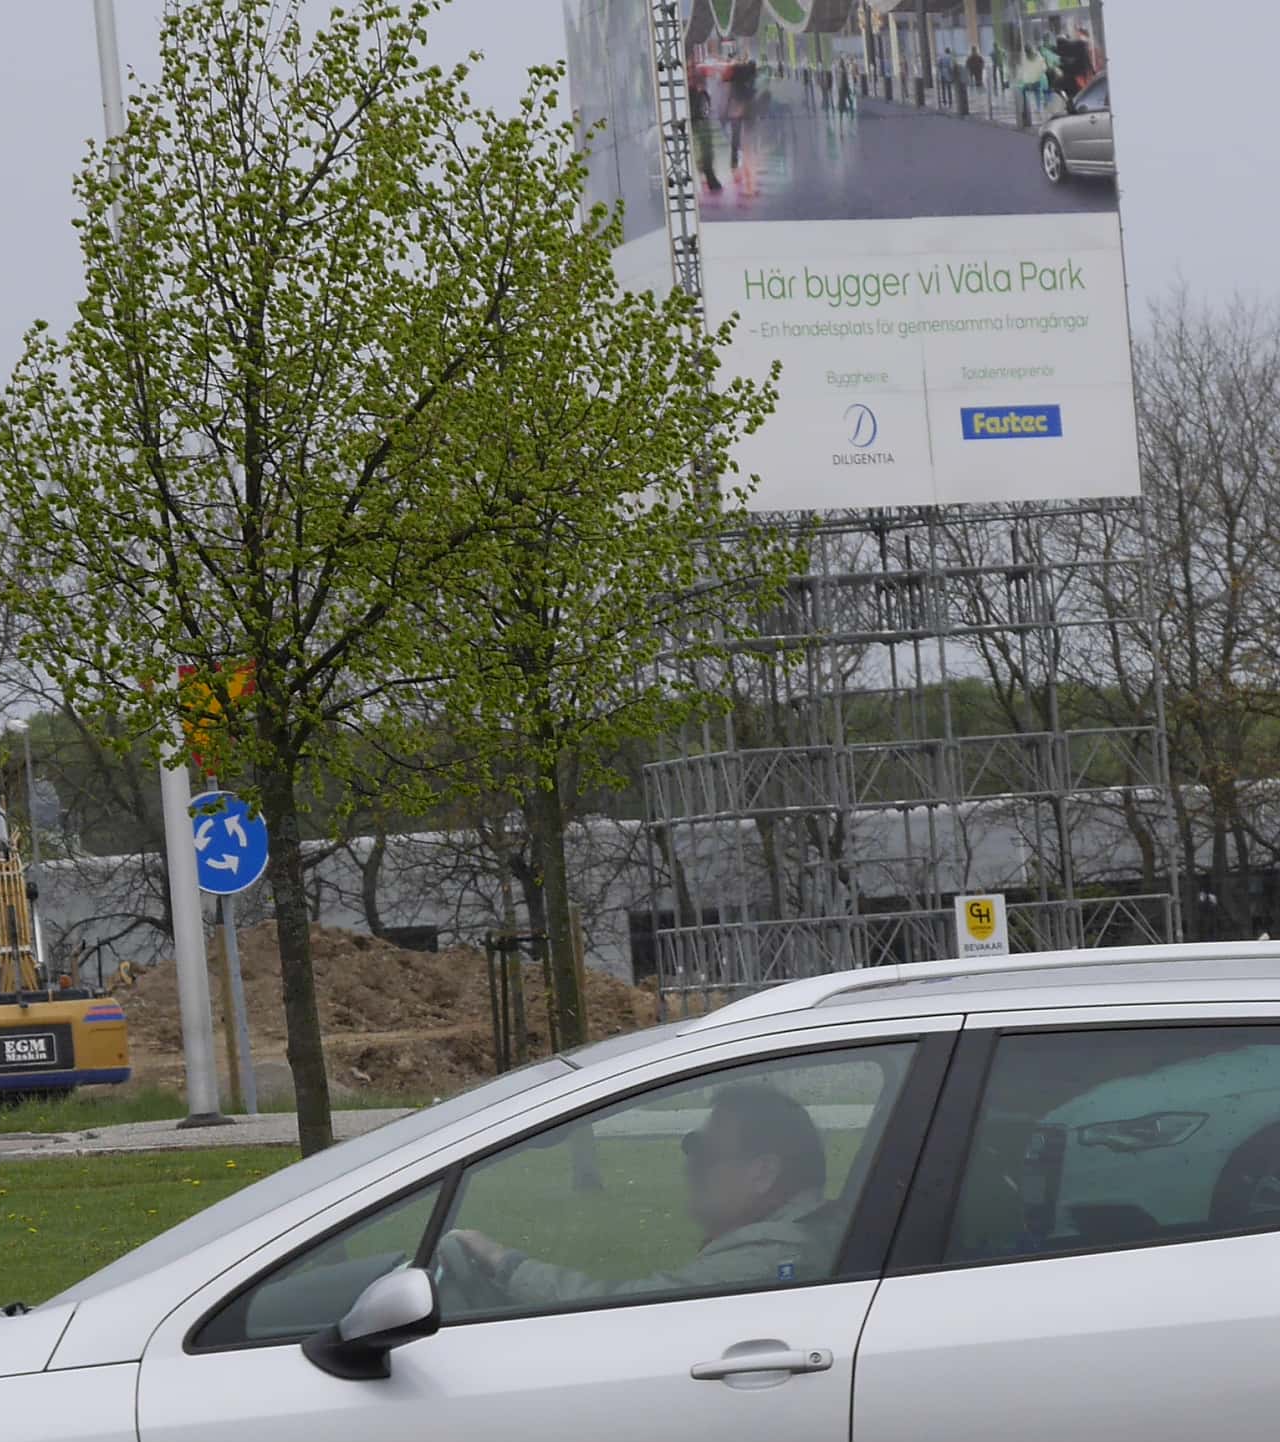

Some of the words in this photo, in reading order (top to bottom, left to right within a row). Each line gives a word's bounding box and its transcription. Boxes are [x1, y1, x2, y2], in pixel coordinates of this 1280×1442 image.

[744, 268, 796, 300] Här
[804, 266, 910, 307] bygger
[919, 264, 941, 295] vi
[947, 260, 1012, 294] Väla
[1020, 258, 1086, 291] Park
[761, 321, 779, 338] En
[973, 412, 1049, 434] Fastec
[832, 453, 895, 465] DILIGENTIA
[4, 1039, 47, 1053] EGM
[5, 1051, 47, 1062] Maskin
